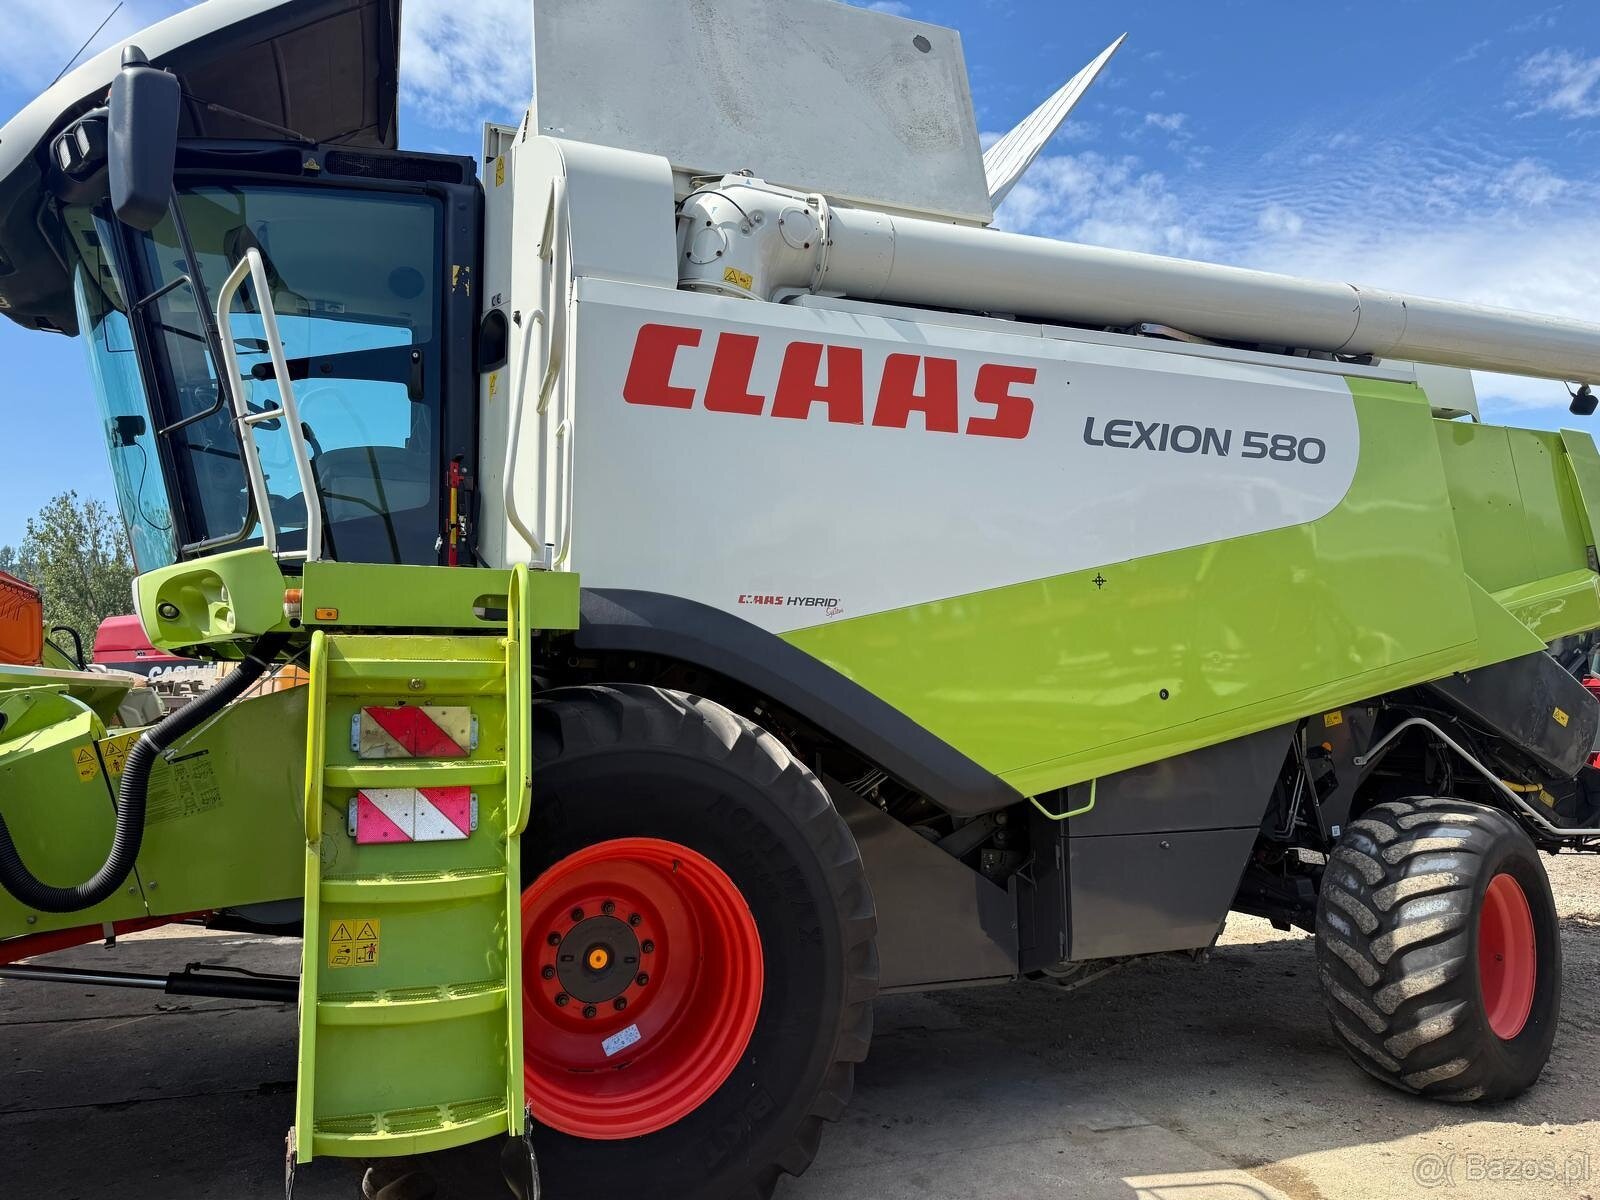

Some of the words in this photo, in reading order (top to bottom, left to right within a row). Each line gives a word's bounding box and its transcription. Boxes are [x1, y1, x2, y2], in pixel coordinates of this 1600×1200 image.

[623, 323, 1037, 439] CLAAS
[1083, 416, 1232, 457] LEXION
[1241, 430, 1326, 464] 580
